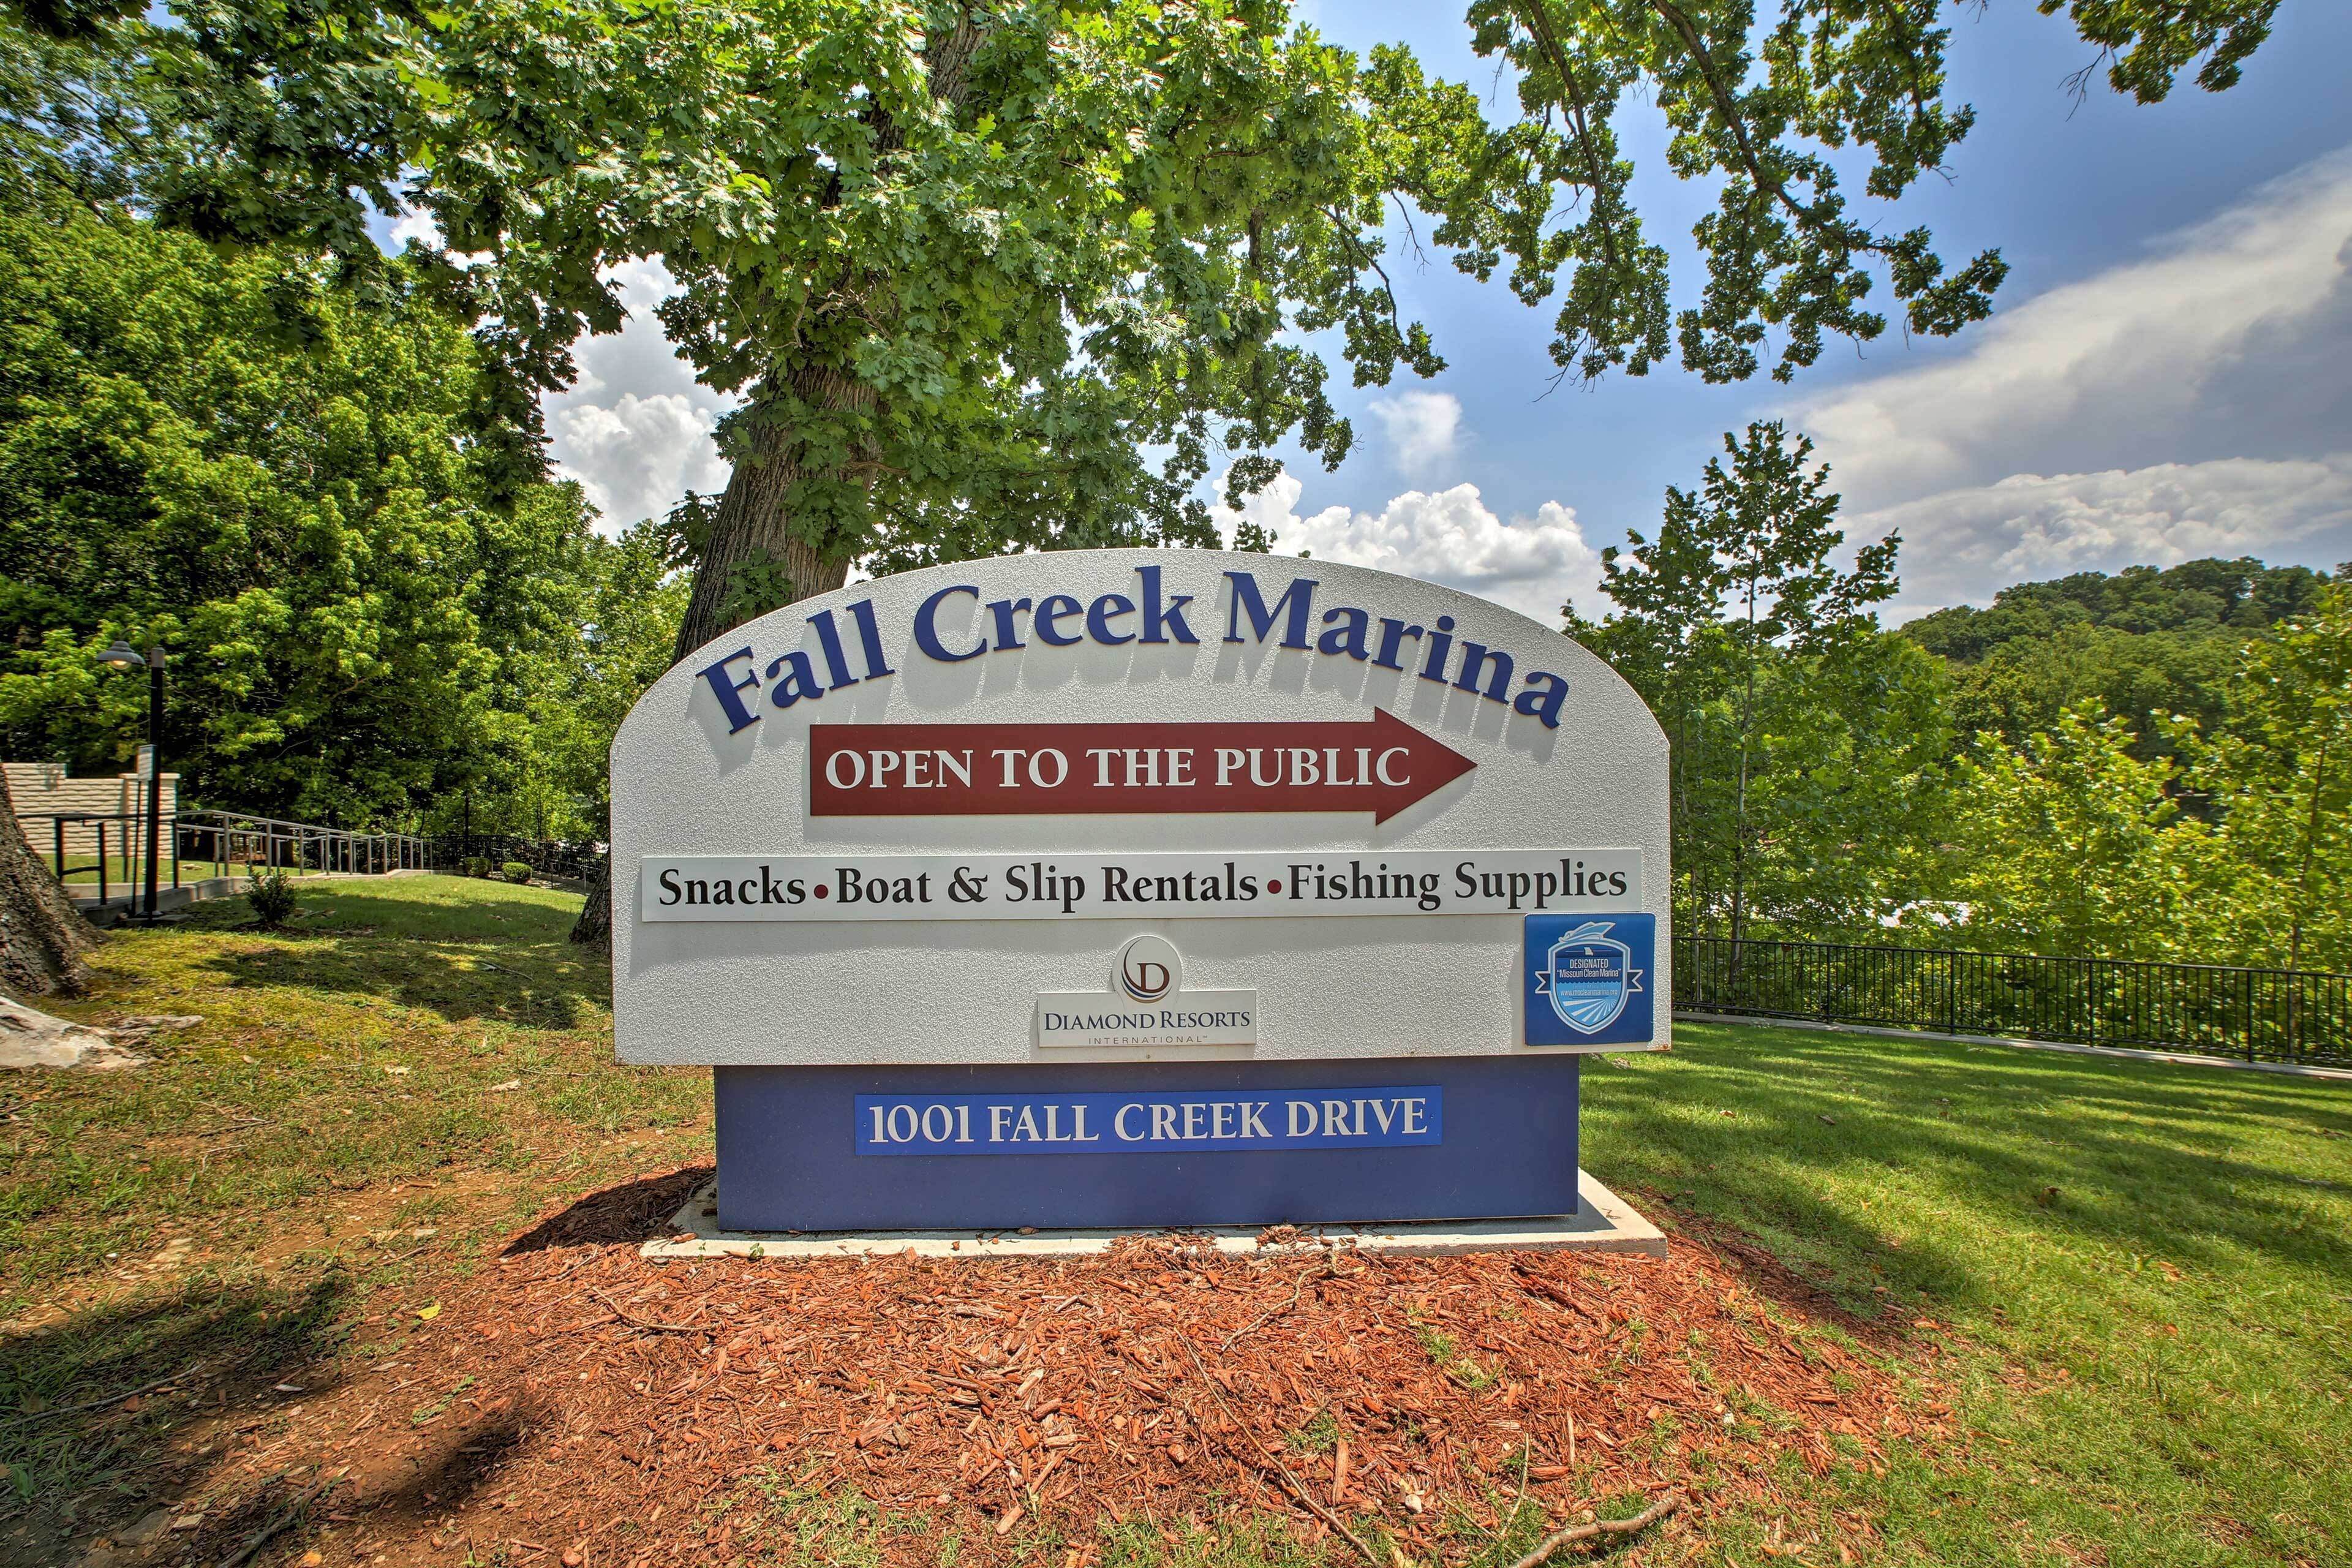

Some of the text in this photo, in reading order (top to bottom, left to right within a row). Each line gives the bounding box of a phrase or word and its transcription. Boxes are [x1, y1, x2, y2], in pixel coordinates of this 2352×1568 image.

[696, 565, 1569, 734] Fall Creek Marina
[826, 747, 1411, 789] OPEN TO THE PUBLIC
[658, 858, 1627, 913] Snacks Boat & Slip Rentals Fishing Supplies
[1137, 962, 1170, 993] D
[1569, 959, 1608, 968] DESIGNATED
[1583, 968, 1599, 978] Clean
[869, 1097, 1428, 1143] 1001 FALL CREEK DRIVE
